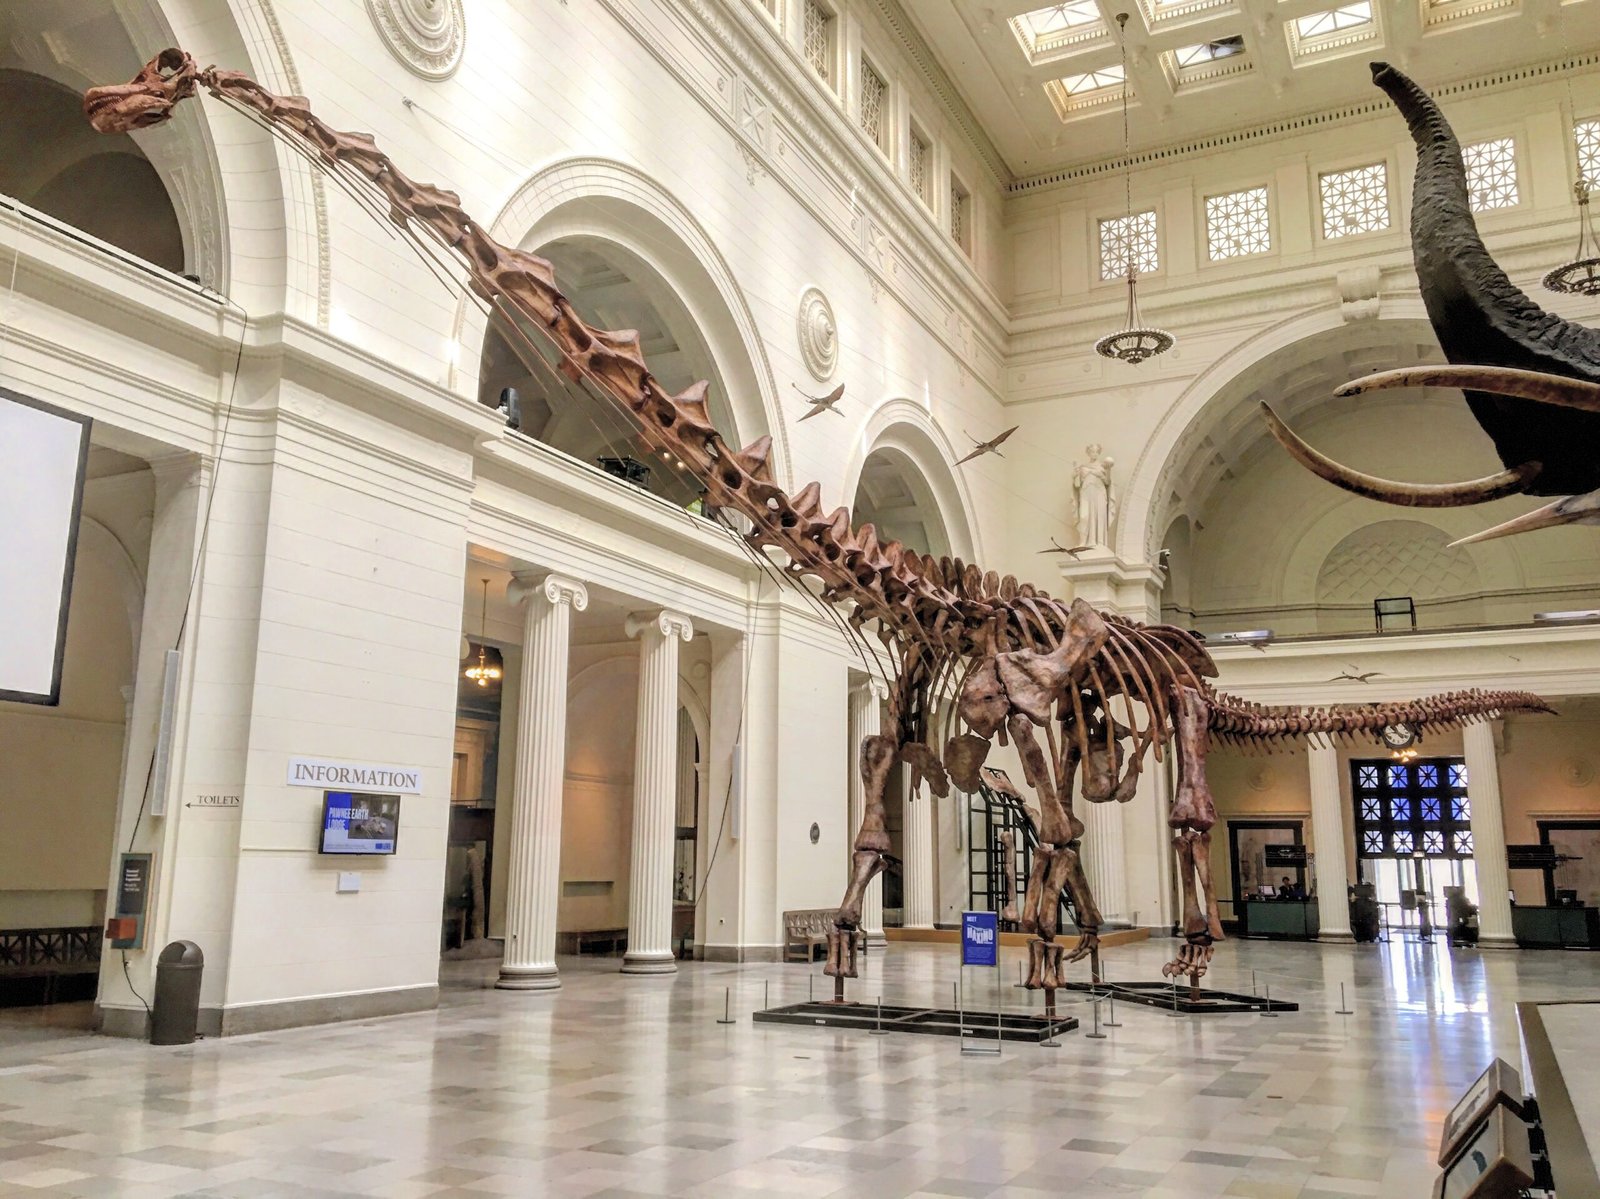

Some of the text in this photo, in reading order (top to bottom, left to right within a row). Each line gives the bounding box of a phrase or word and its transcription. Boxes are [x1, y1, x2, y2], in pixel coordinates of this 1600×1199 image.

[295, 763, 418, 788] INFORMATION
[196, 795, 240, 804] TOILETS
[351, 808, 369, 820] EARTH
